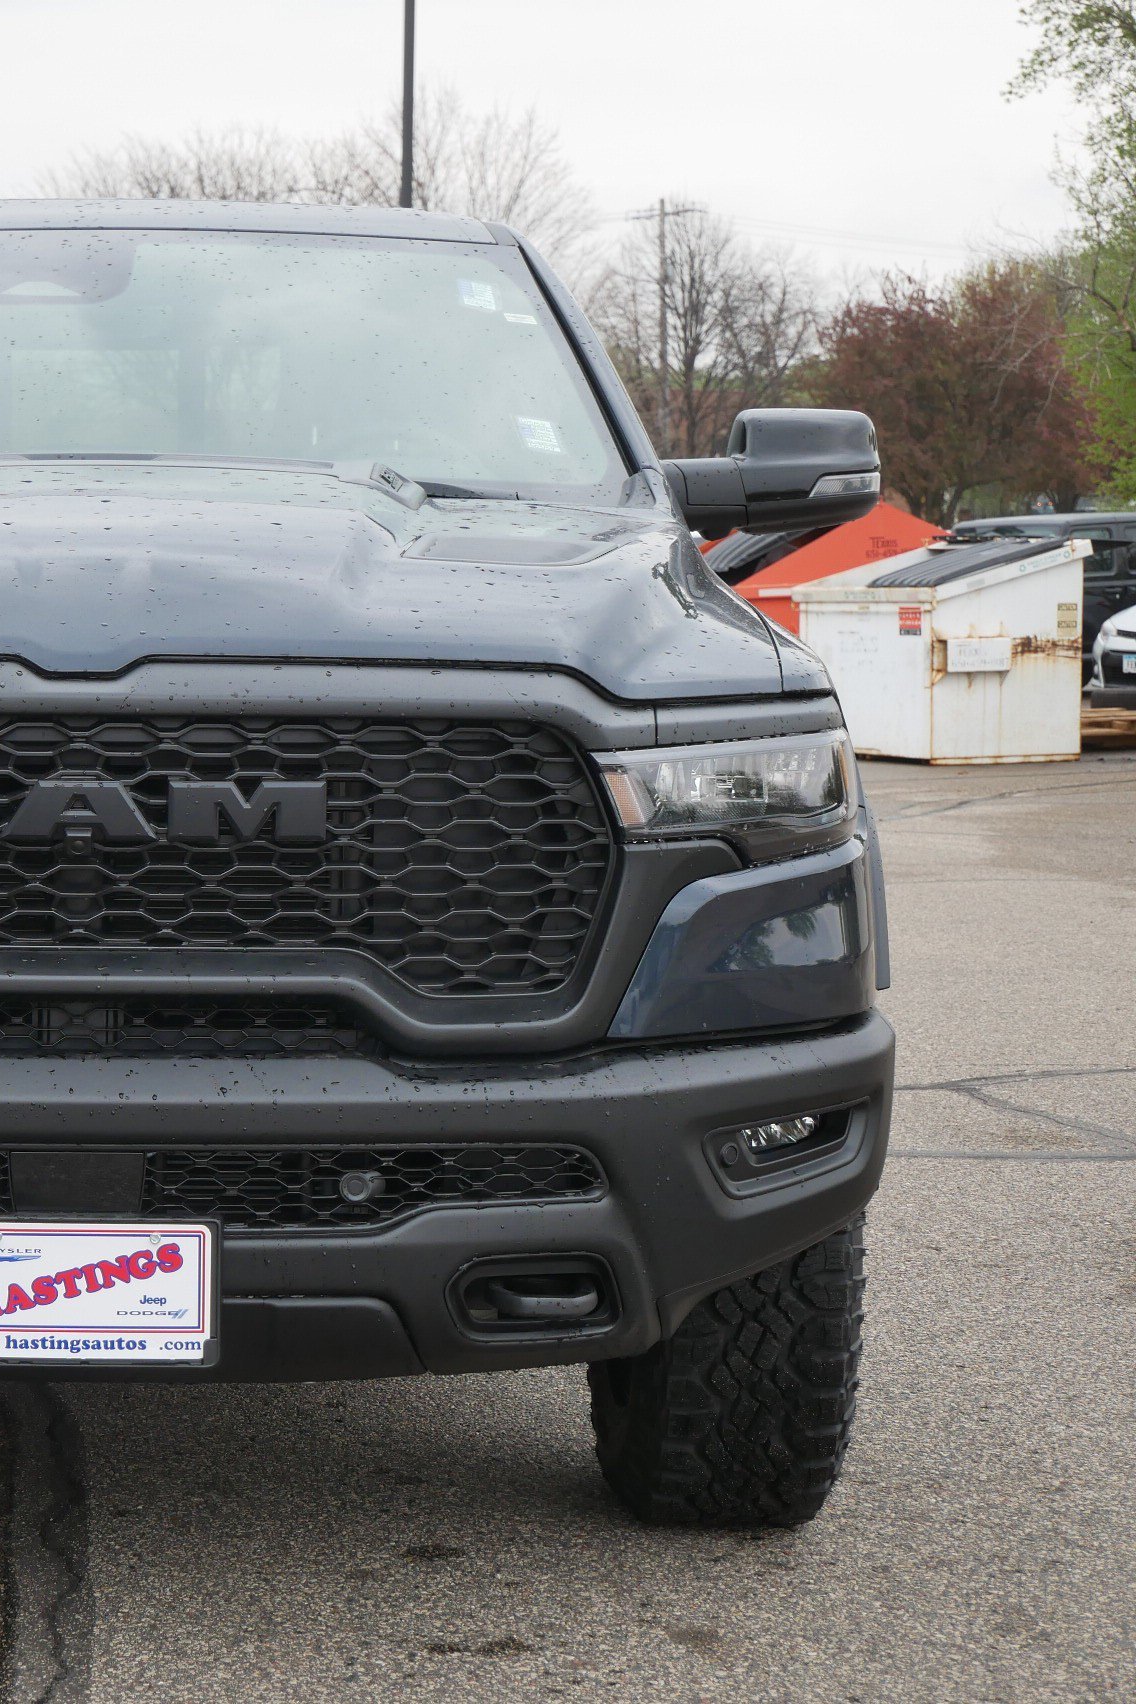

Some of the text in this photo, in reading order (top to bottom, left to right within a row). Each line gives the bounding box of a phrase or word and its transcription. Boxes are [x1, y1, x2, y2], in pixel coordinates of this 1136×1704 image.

[139, 1295, 167, 1306] Jeep
[5, 1335, 147, 1353] hastingsautos
[159, 1339, 202, 1351] .com
